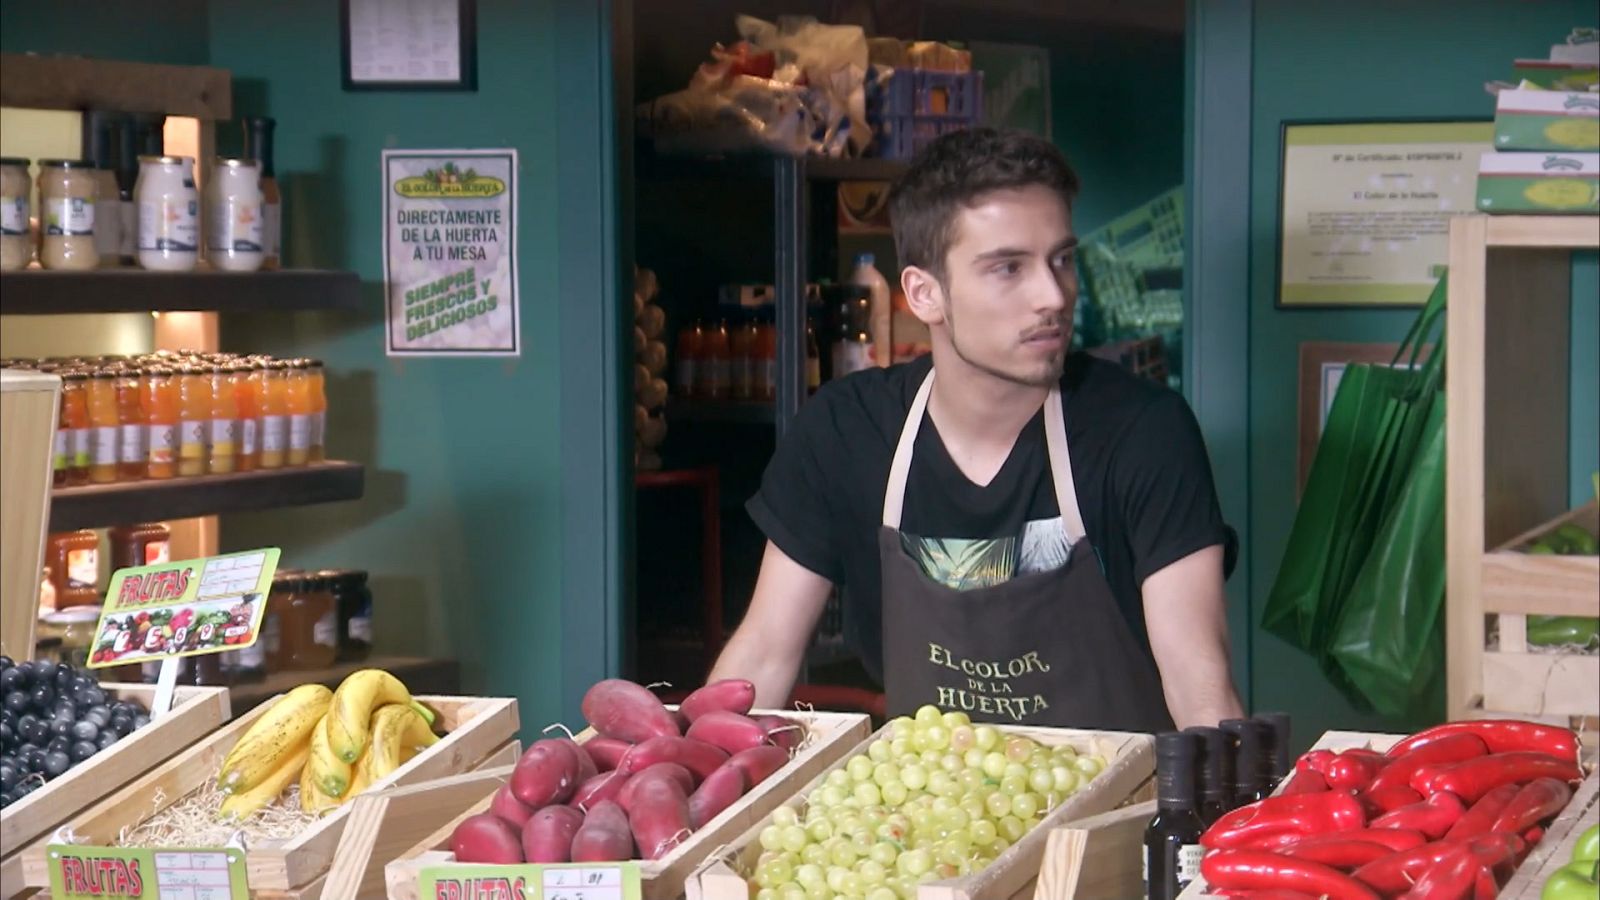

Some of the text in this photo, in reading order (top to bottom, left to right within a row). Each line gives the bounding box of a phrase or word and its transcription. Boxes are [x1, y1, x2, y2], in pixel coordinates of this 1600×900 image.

[397, 210, 501, 225] DIRECTAMENTE
[402, 228, 498, 243] DE LA HUERTA
[413, 246, 487, 261] A TU MESA
[405, 266, 475, 307] SIEMPRE
[405, 278, 492, 325] FRESCOS Y
[406, 294, 498, 342] DELICIOSOS
[117, 568, 192, 607] FRUTAS
[928, 642, 1050, 679] EL COLOR
[937, 686, 1049, 721] HUERTA
[967, 678, 1012, 693] DE LA
[62, 855, 144, 897] FRUTAS
